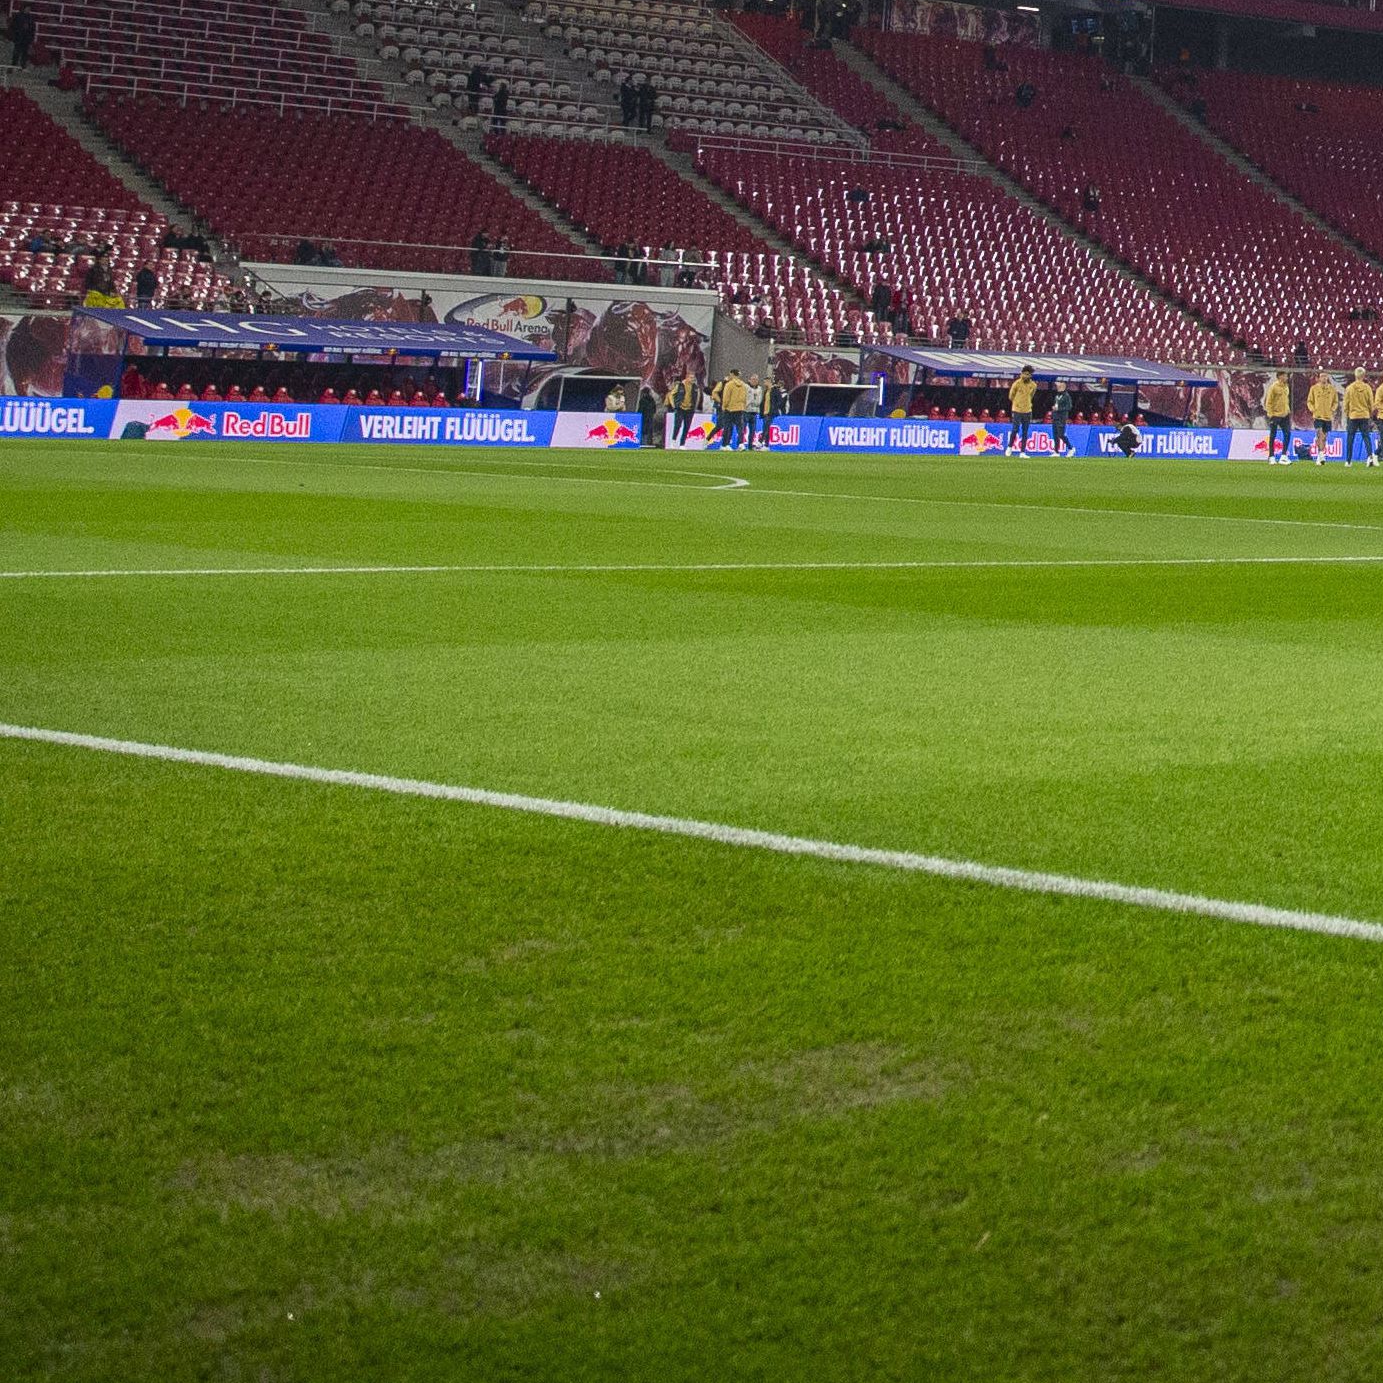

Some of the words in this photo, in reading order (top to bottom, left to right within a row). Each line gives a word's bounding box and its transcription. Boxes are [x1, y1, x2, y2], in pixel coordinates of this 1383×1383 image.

[125, 315, 308, 336] IHG
[491, 319, 513, 333] Bull
[514, 320, 549, 334] Arena
[222, 411, 268, 438] Red
[269, 412, 311, 438] Bull
[360, 415, 441, 440] VERLEIHT
[768, 425, 800, 446] Bull
[828, 426, 887, 447] VERLEIHT
